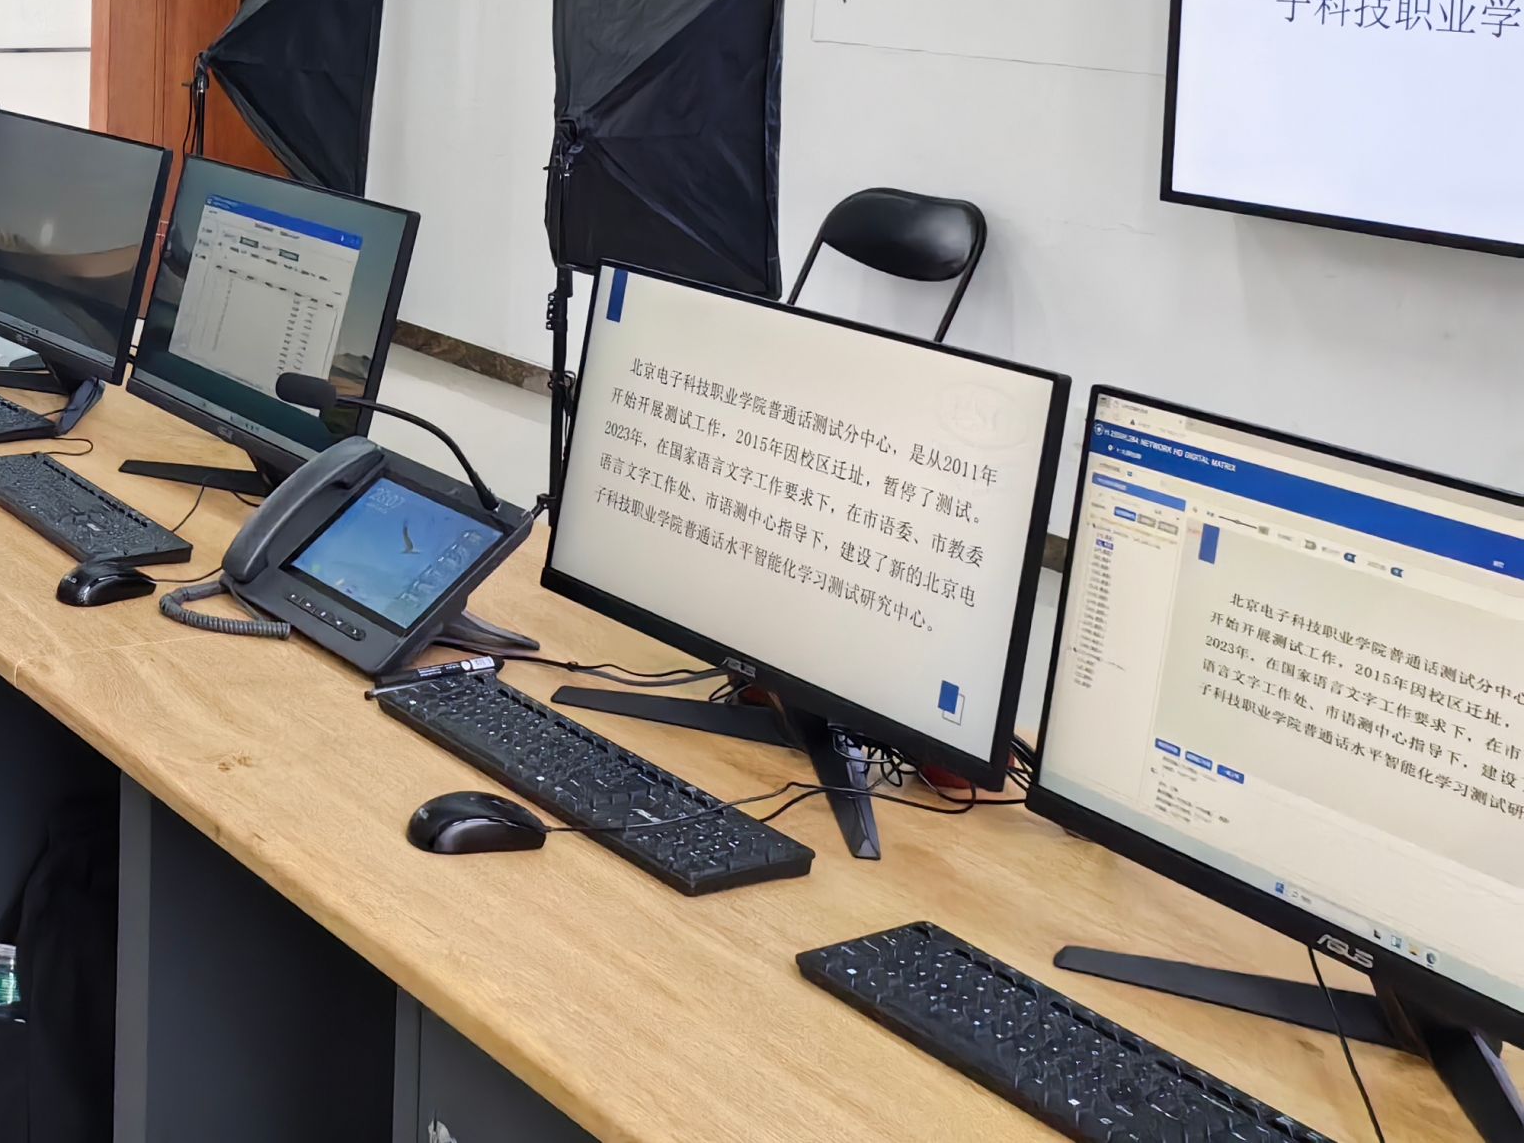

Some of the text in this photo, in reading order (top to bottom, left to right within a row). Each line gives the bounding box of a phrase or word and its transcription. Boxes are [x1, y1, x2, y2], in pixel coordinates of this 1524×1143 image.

[1203, 658, 1524, 793] 语言文字工作处、市语测中心指导下，建设
[1316, 933, 1375, 970] ASUS
